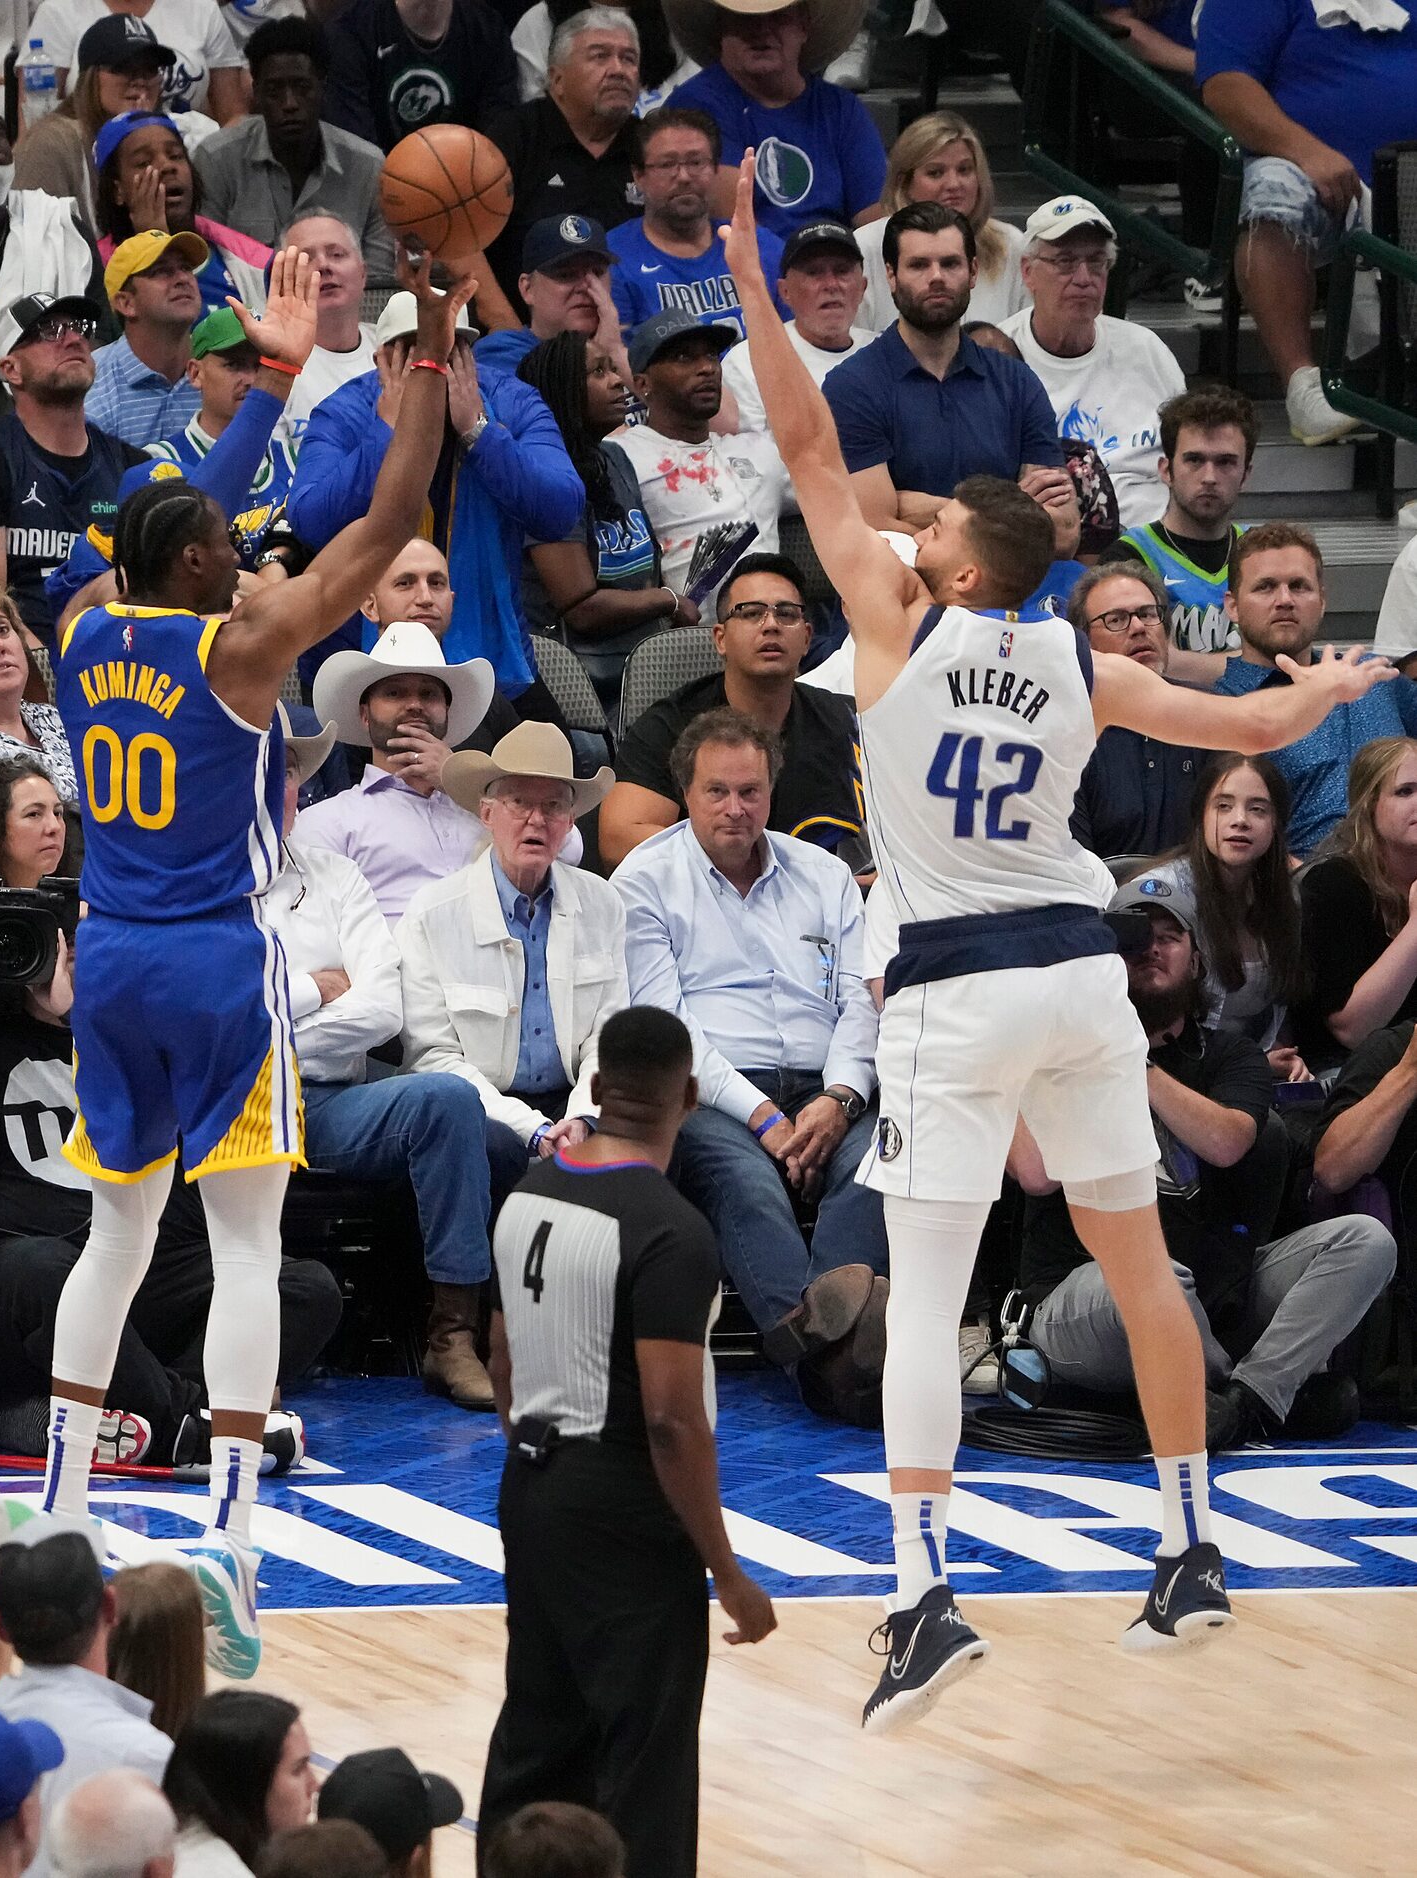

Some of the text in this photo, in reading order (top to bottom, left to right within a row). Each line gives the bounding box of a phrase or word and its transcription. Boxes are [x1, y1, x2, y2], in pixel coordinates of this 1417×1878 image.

[78, 660, 186, 720] KUMINGA
[946, 667, 1050, 724] KLEBER
[82, 724, 177, 831] 00
[926, 732, 1044, 841] 42
[523, 1220, 553, 1303] 4
